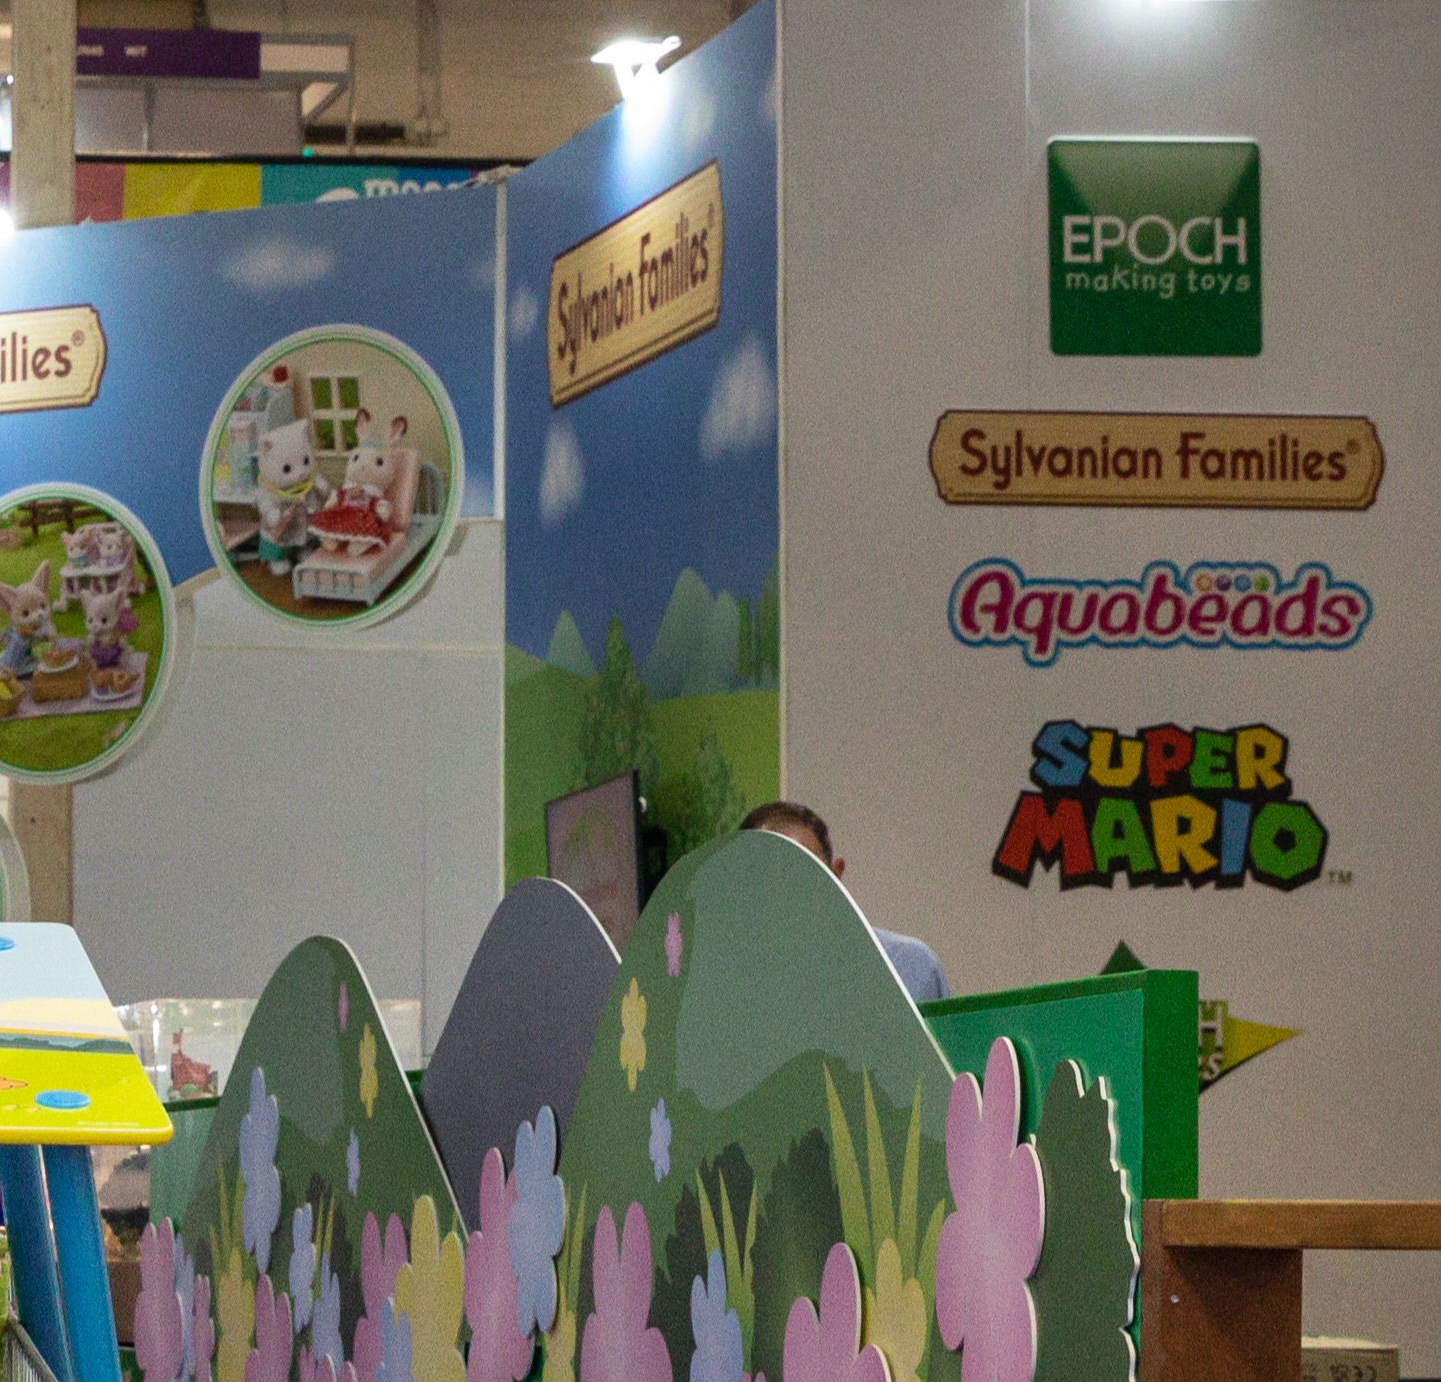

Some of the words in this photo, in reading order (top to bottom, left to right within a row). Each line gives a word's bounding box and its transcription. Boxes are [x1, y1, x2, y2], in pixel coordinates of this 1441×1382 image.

[1062, 215, 1248, 266] EPOCH
[557, 261, 635, 376] Sylvanian
[1066, 264, 1176, 300] making
[1185, 268, 1251, 295] toys
[959, 428, 1163, 491] Sylvanian
[960, 571, 1361, 656] Aquabeads
[1031, 720, 1289, 794] SUPER
[995, 792, 1327, 888] MARIO
